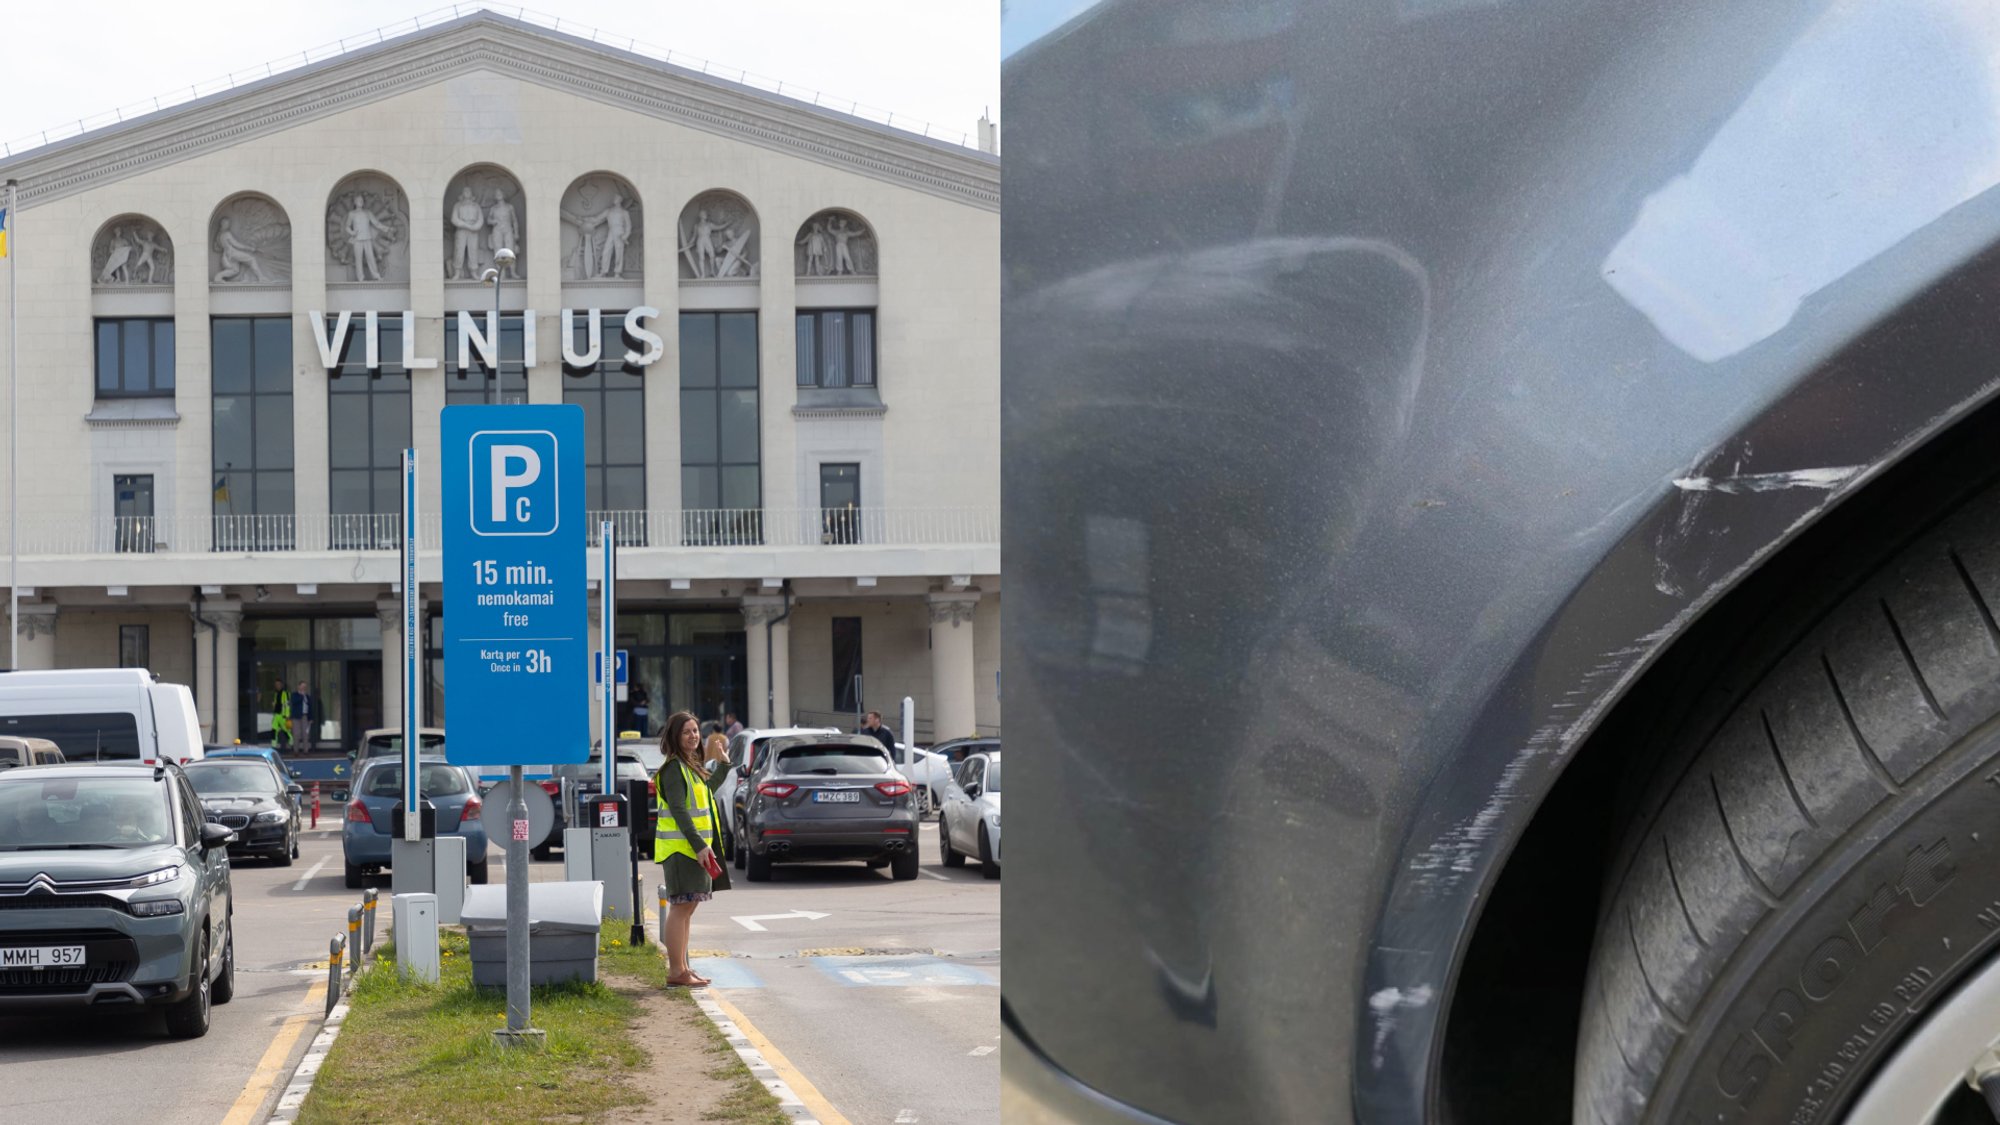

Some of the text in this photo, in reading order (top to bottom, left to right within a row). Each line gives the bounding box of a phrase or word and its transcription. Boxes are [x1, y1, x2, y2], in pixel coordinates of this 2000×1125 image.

[309, 306, 664, 369] VILNIUS
[473, 560, 553, 585] 15 min.
[477, 590, 554, 606] nemokamai
[503, 612, 529, 627] free
[480, 649, 521, 662] Kartą per
[525, 649, 552, 673] 3h
[490, 662, 521, 673] Once in
[3, 948, 83, 965] MMH 957
